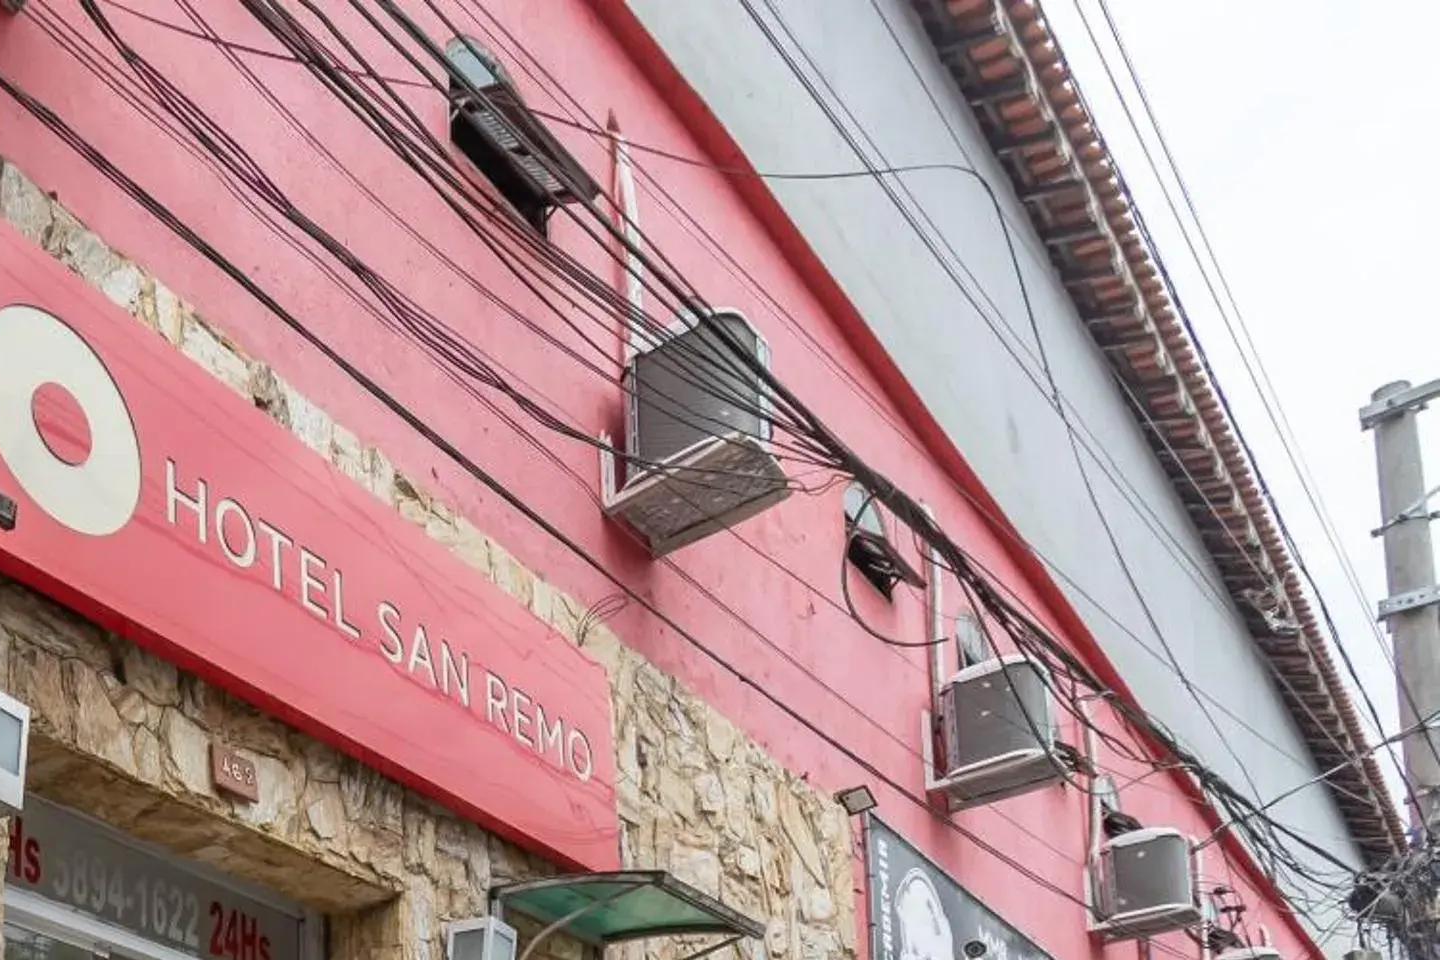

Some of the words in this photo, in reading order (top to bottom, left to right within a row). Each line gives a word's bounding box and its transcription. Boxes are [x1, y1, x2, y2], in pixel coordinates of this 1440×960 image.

[165, 458, 362, 639] HOTEL
[377, 599, 472, 706] SAN
[484, 671, 594, 783] REMO
